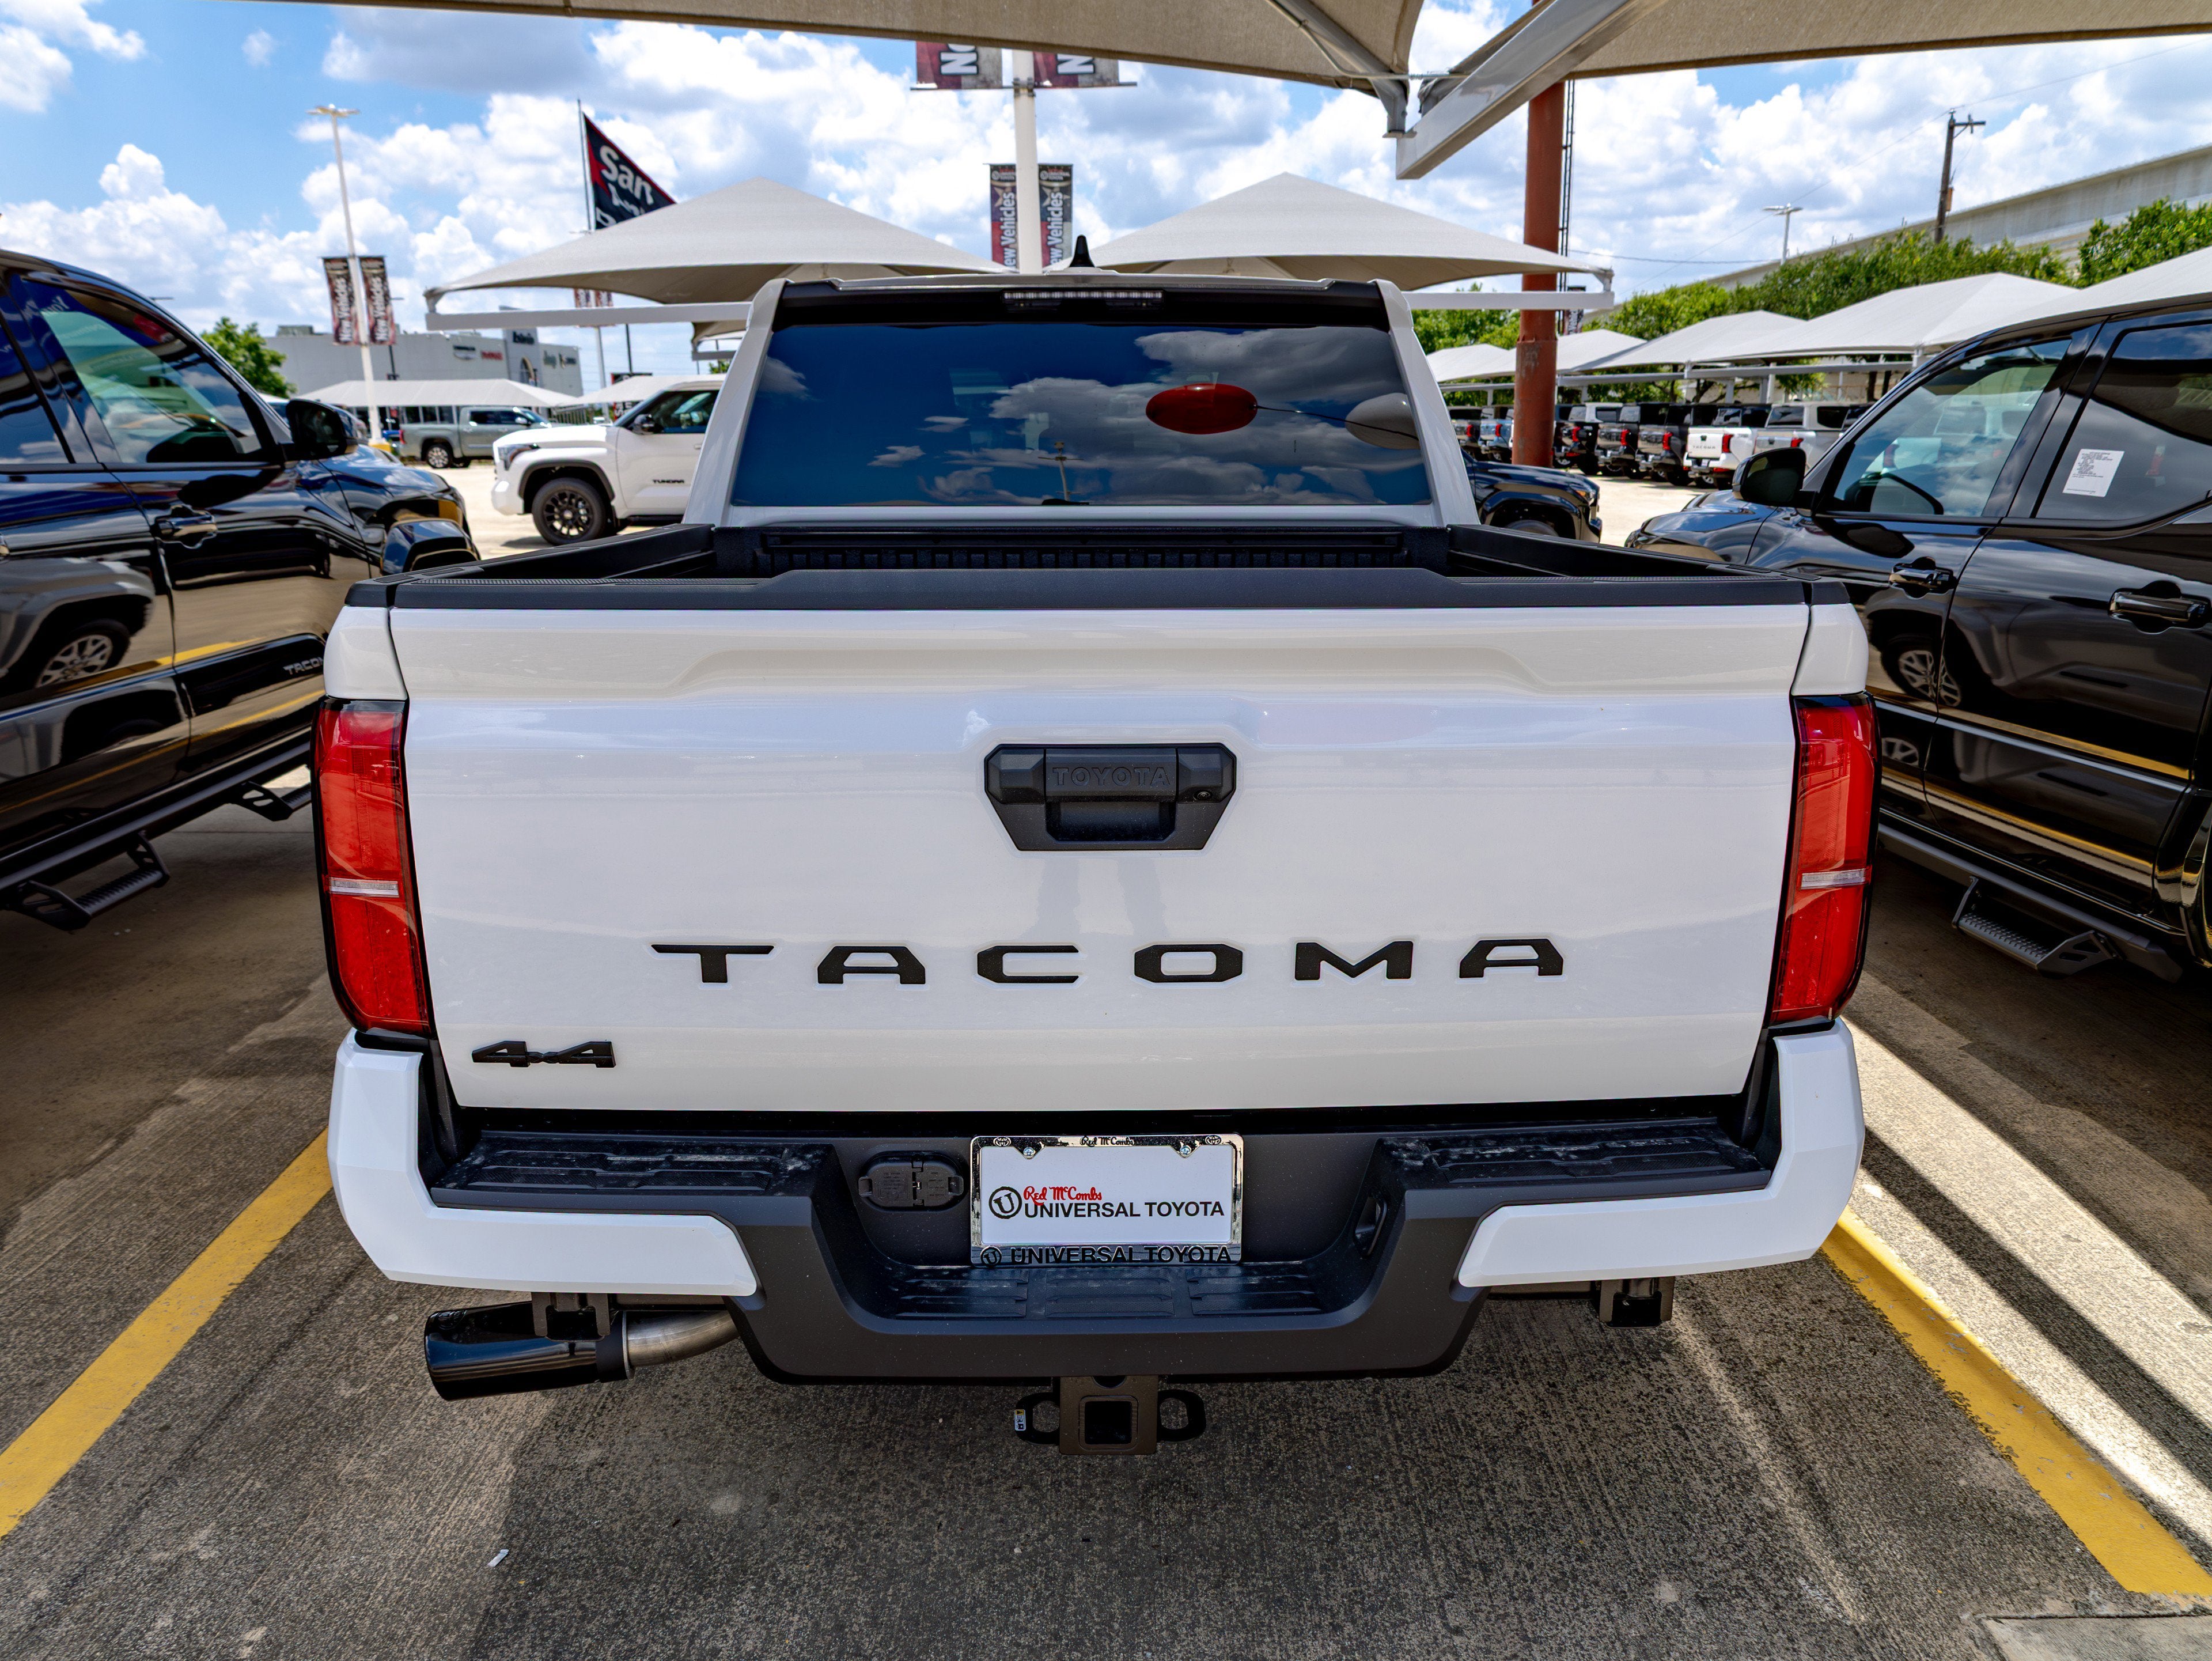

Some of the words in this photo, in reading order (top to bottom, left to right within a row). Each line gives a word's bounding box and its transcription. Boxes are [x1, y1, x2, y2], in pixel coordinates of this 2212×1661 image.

[600, 144, 654, 205] San
[999, 192, 1016, 247] Vehicles
[1047, 191, 1063, 246] Vehicles
[1052, 767, 1171, 786] TOYOTA
[650, 939, 1564, 985] TACOMA
[1080, 1135, 1098, 1147] Red
[1098, 1136, 1134, 1146] McCombs
[1023, 1186, 1047, 1206] Red
[1048, 1186, 1102, 1201] McCombs
[1024, 1202, 1140, 1219] UNIVERSAL
[1145, 1201, 1225, 1217] TOYOTA
[1011, 1246, 1141, 1264] UNIVERSAL
[1143, 1245, 1232, 1263] TOYOTA
